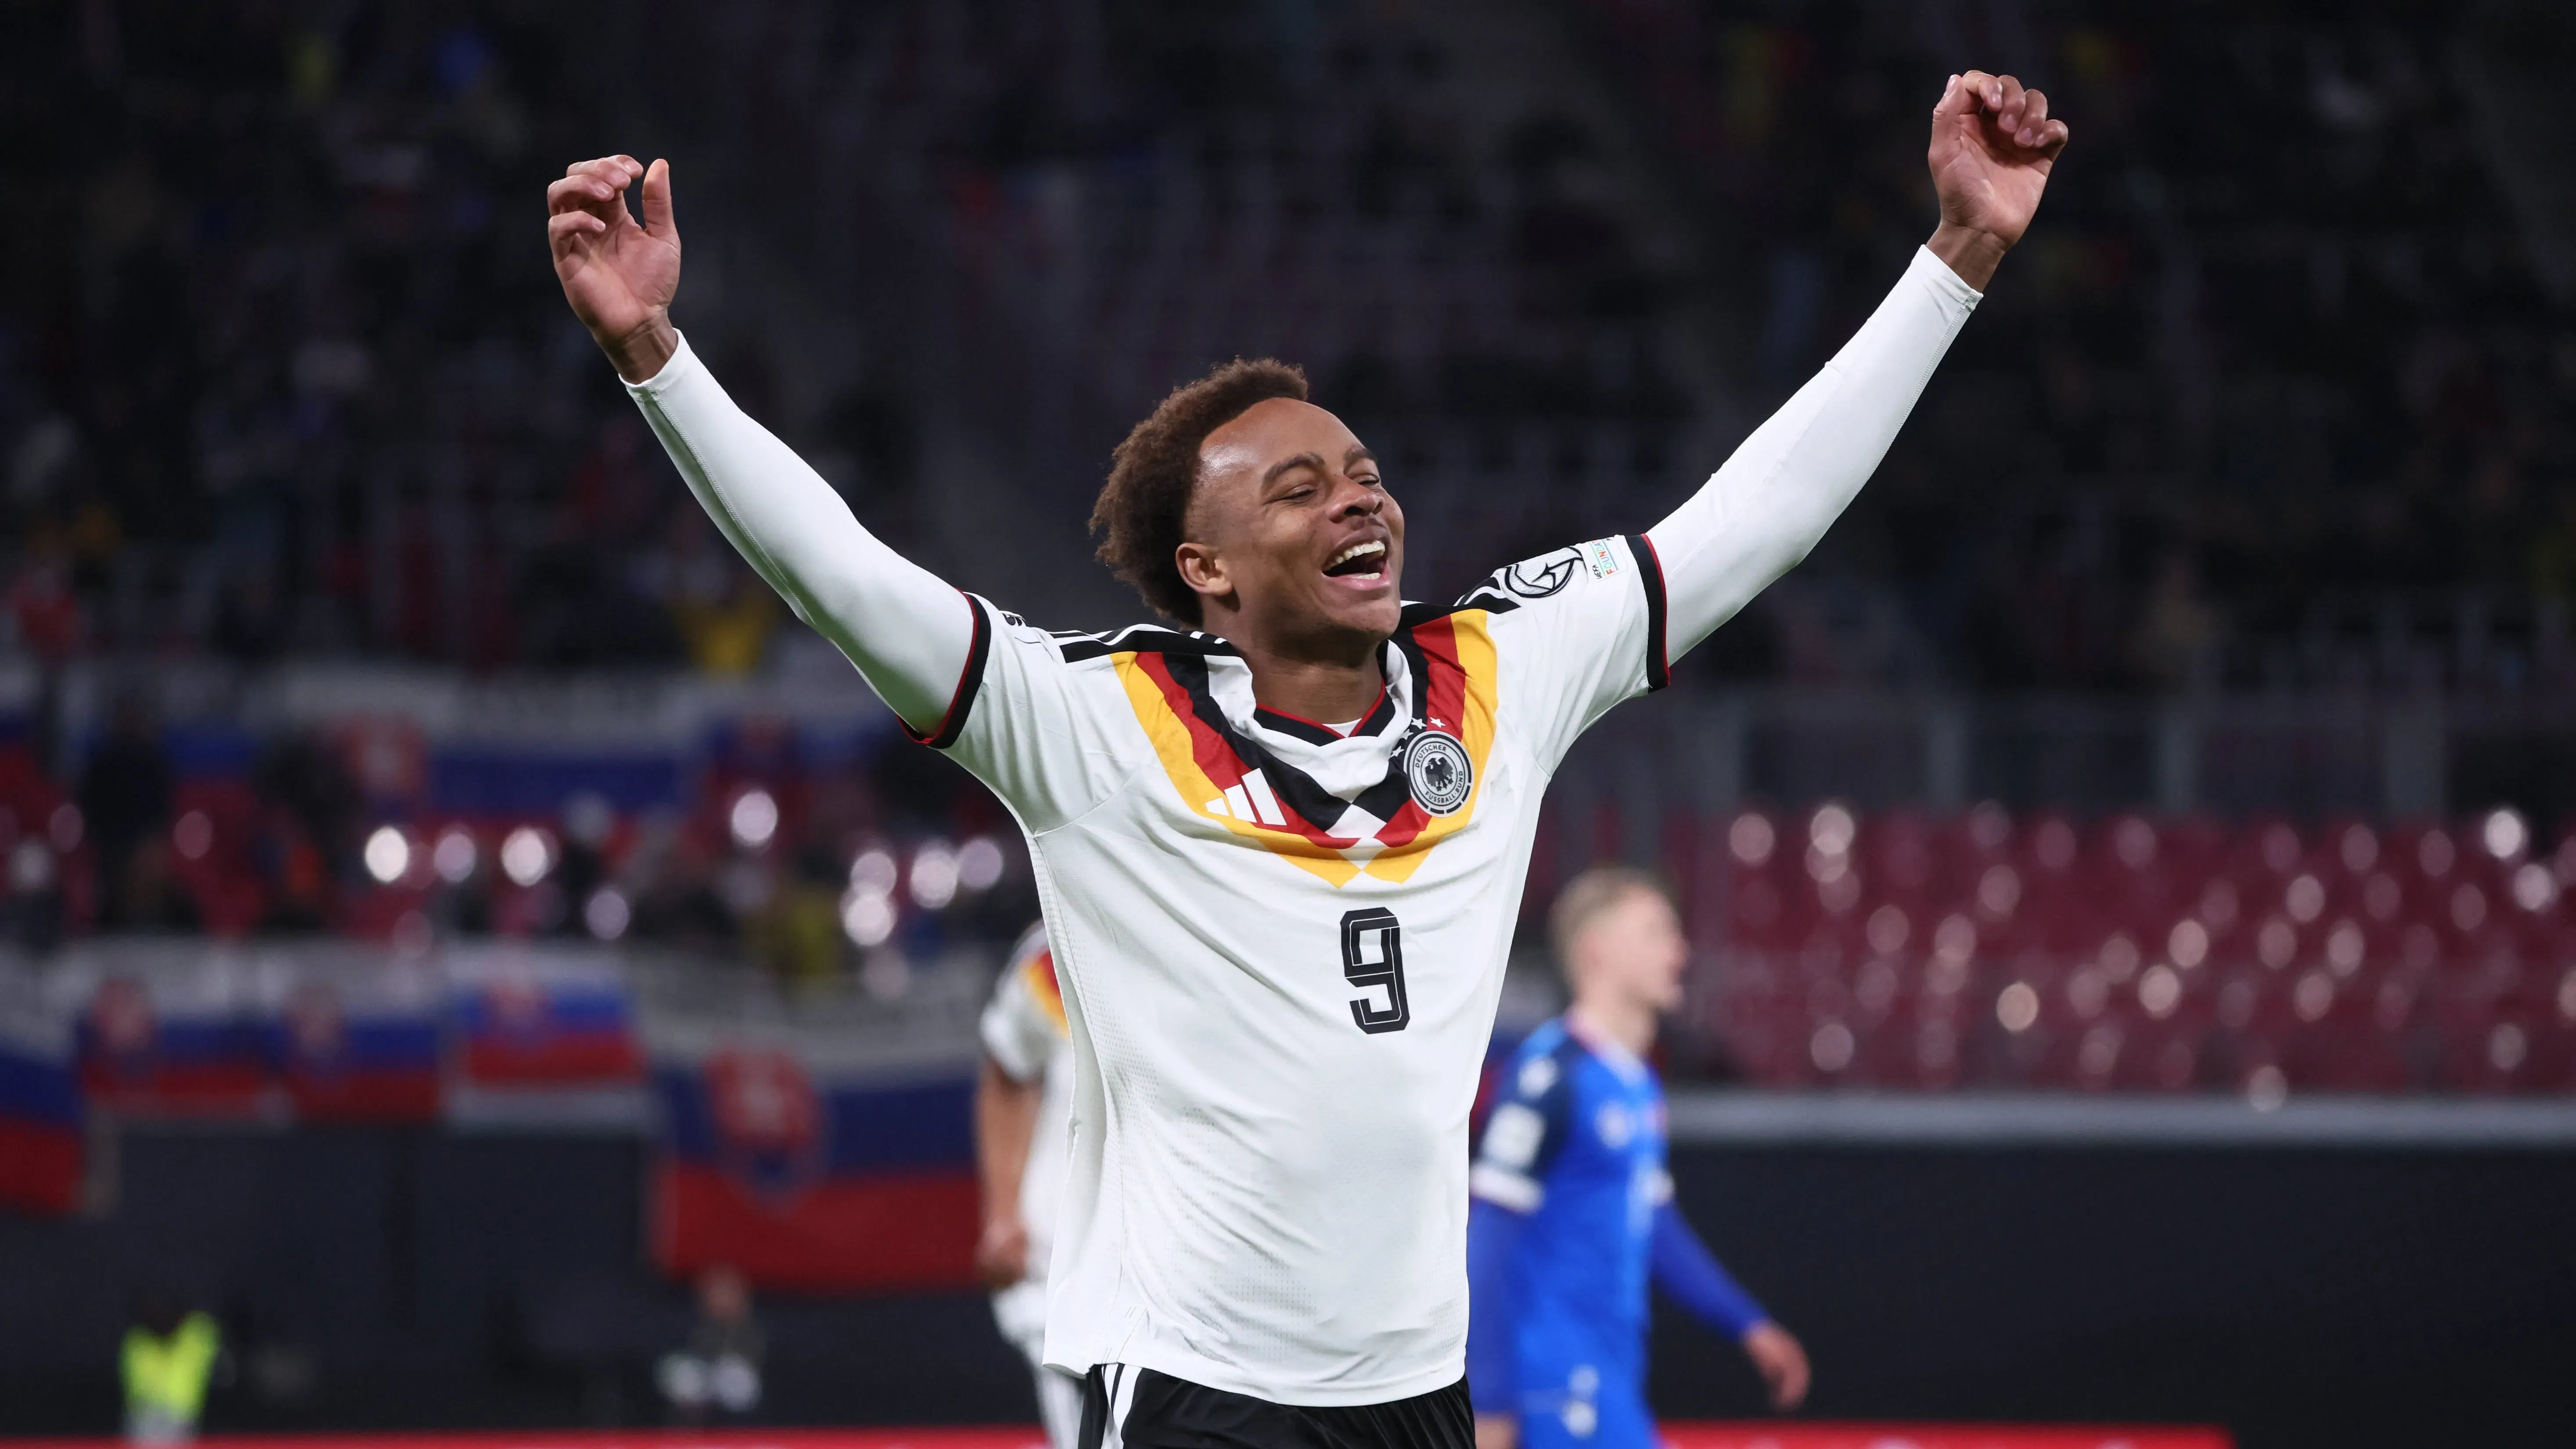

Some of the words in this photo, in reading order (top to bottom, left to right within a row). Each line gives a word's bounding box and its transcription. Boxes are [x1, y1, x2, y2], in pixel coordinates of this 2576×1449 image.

[1592, 564, 1602, 579] UEFA
[1415, 745, 1446, 768] DEUTSCHER
[1340, 907, 1410, 1034] 9
